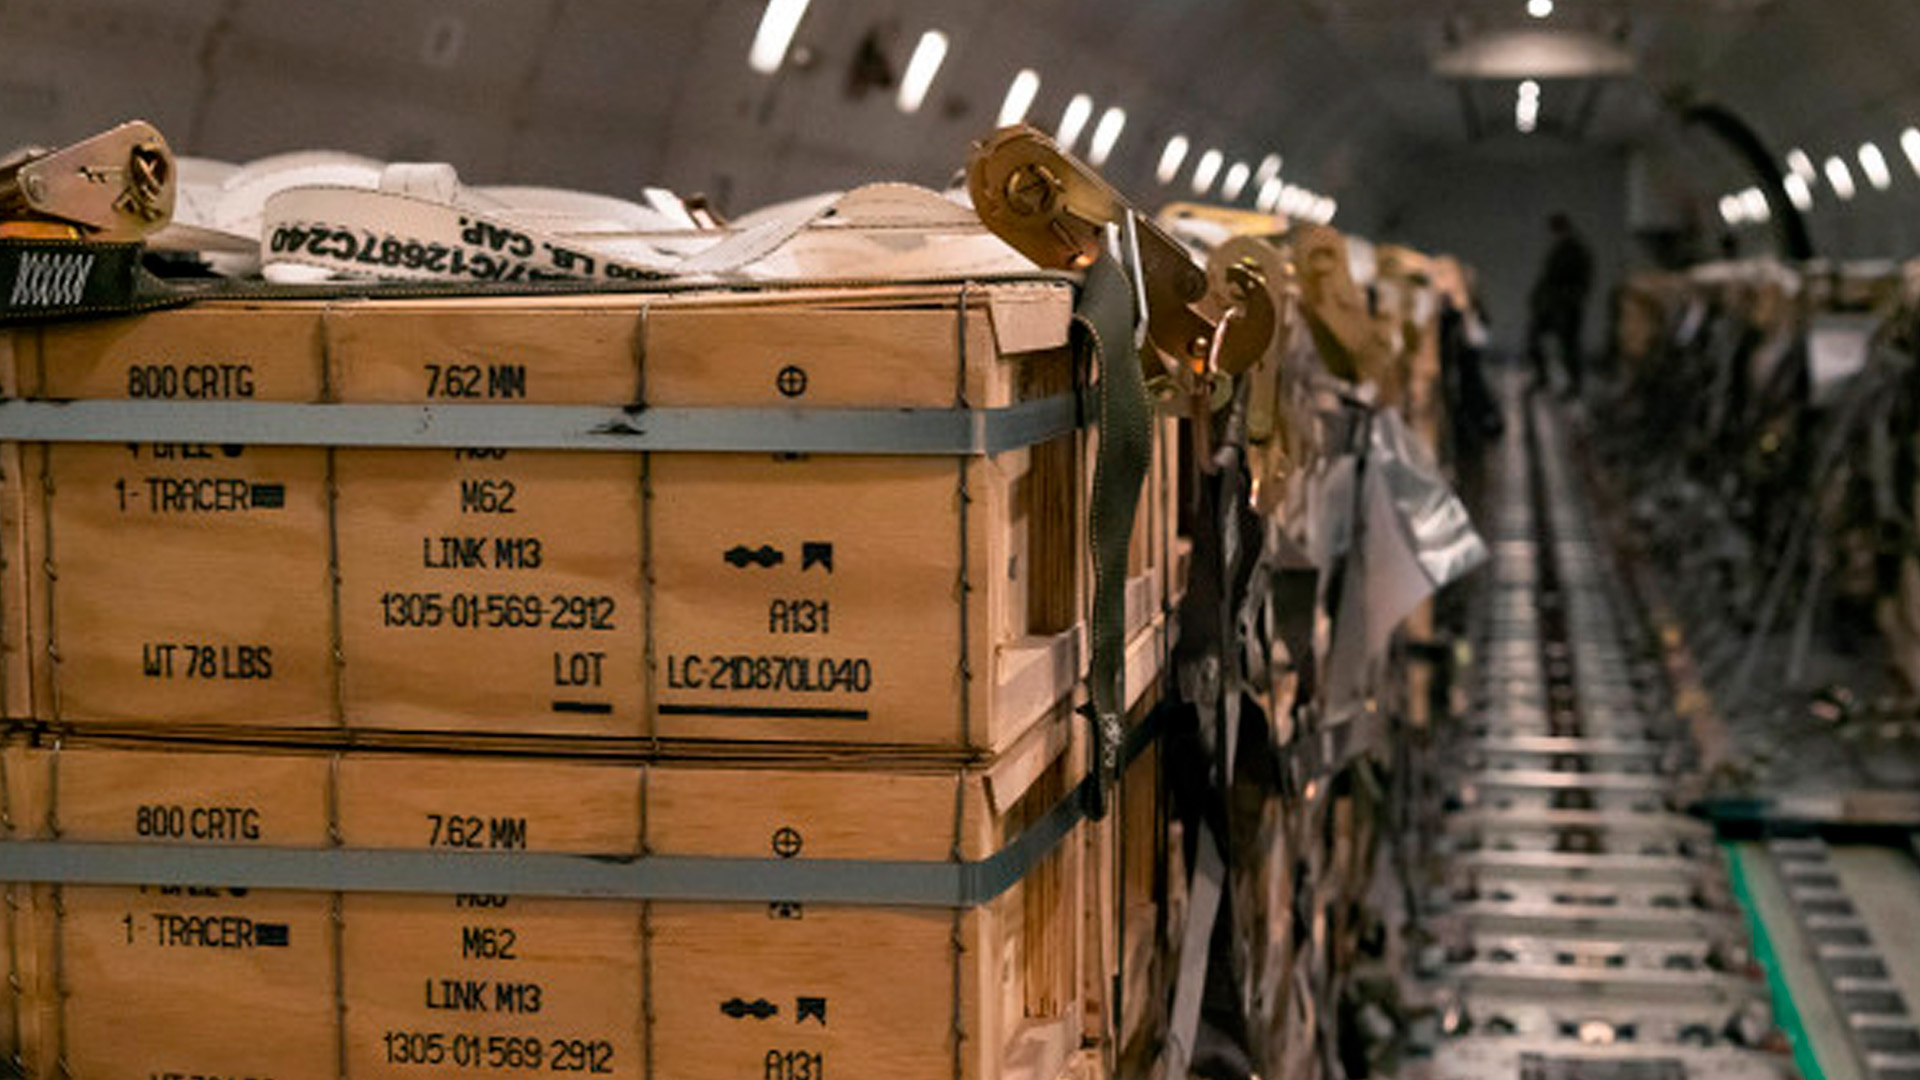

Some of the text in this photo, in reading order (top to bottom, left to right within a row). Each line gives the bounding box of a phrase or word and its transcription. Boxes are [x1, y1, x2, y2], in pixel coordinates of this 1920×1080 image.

[458, 216, 534, 258] CAP.
[543, 241, 593, 275] LB.
[129, 364, 254, 400] 800 CRTG
[424, 364, 526, 399] 7.62 MM
[144, 477, 249, 512] TRACER
[461, 479, 516, 513] M62
[423, 537, 543, 569] LINK M13
[769, 600, 829, 633] A131
[143, 644, 273, 680] WT 78 LBS
[553, 652, 606, 687] LOT
[136, 806, 260, 840] 800 CRTG
[427, 814, 526, 850] 7.62 MM
[152, 912, 253, 948] TRACER
[462, 926, 517, 960] M62
[425, 979, 542, 1014] LINK M13
[764, 1049, 823, 1080] A131
